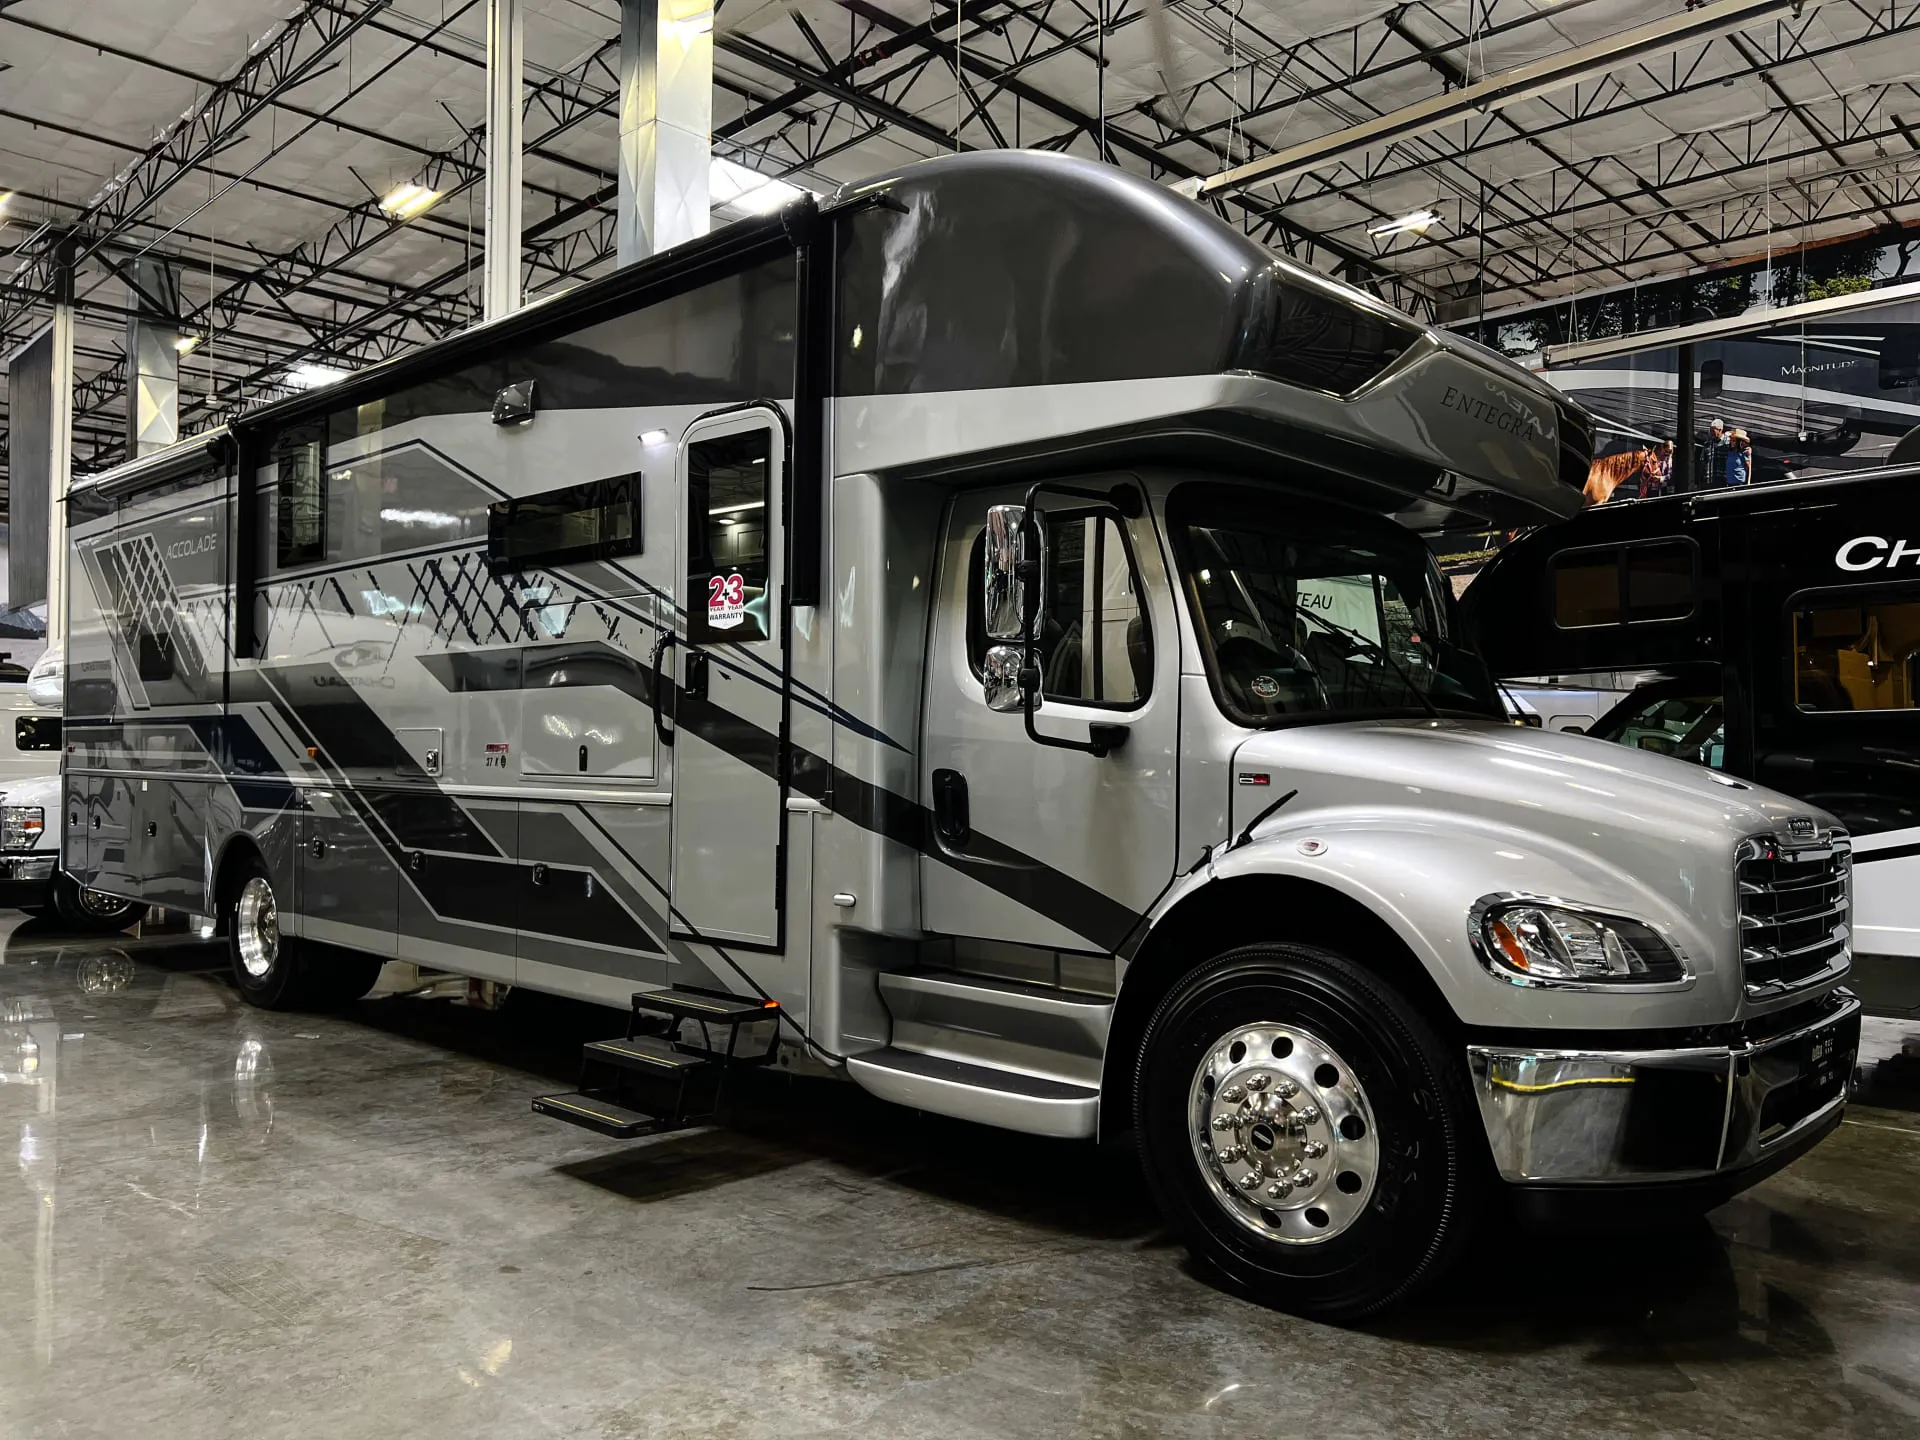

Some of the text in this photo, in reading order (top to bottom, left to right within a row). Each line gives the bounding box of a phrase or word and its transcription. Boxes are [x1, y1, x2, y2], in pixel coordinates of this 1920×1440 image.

[1440, 386, 1533, 440] ENTEGRA
[165, 533, 217, 560] ACCOLADE
[710, 612, 743, 621] WARRANTY
